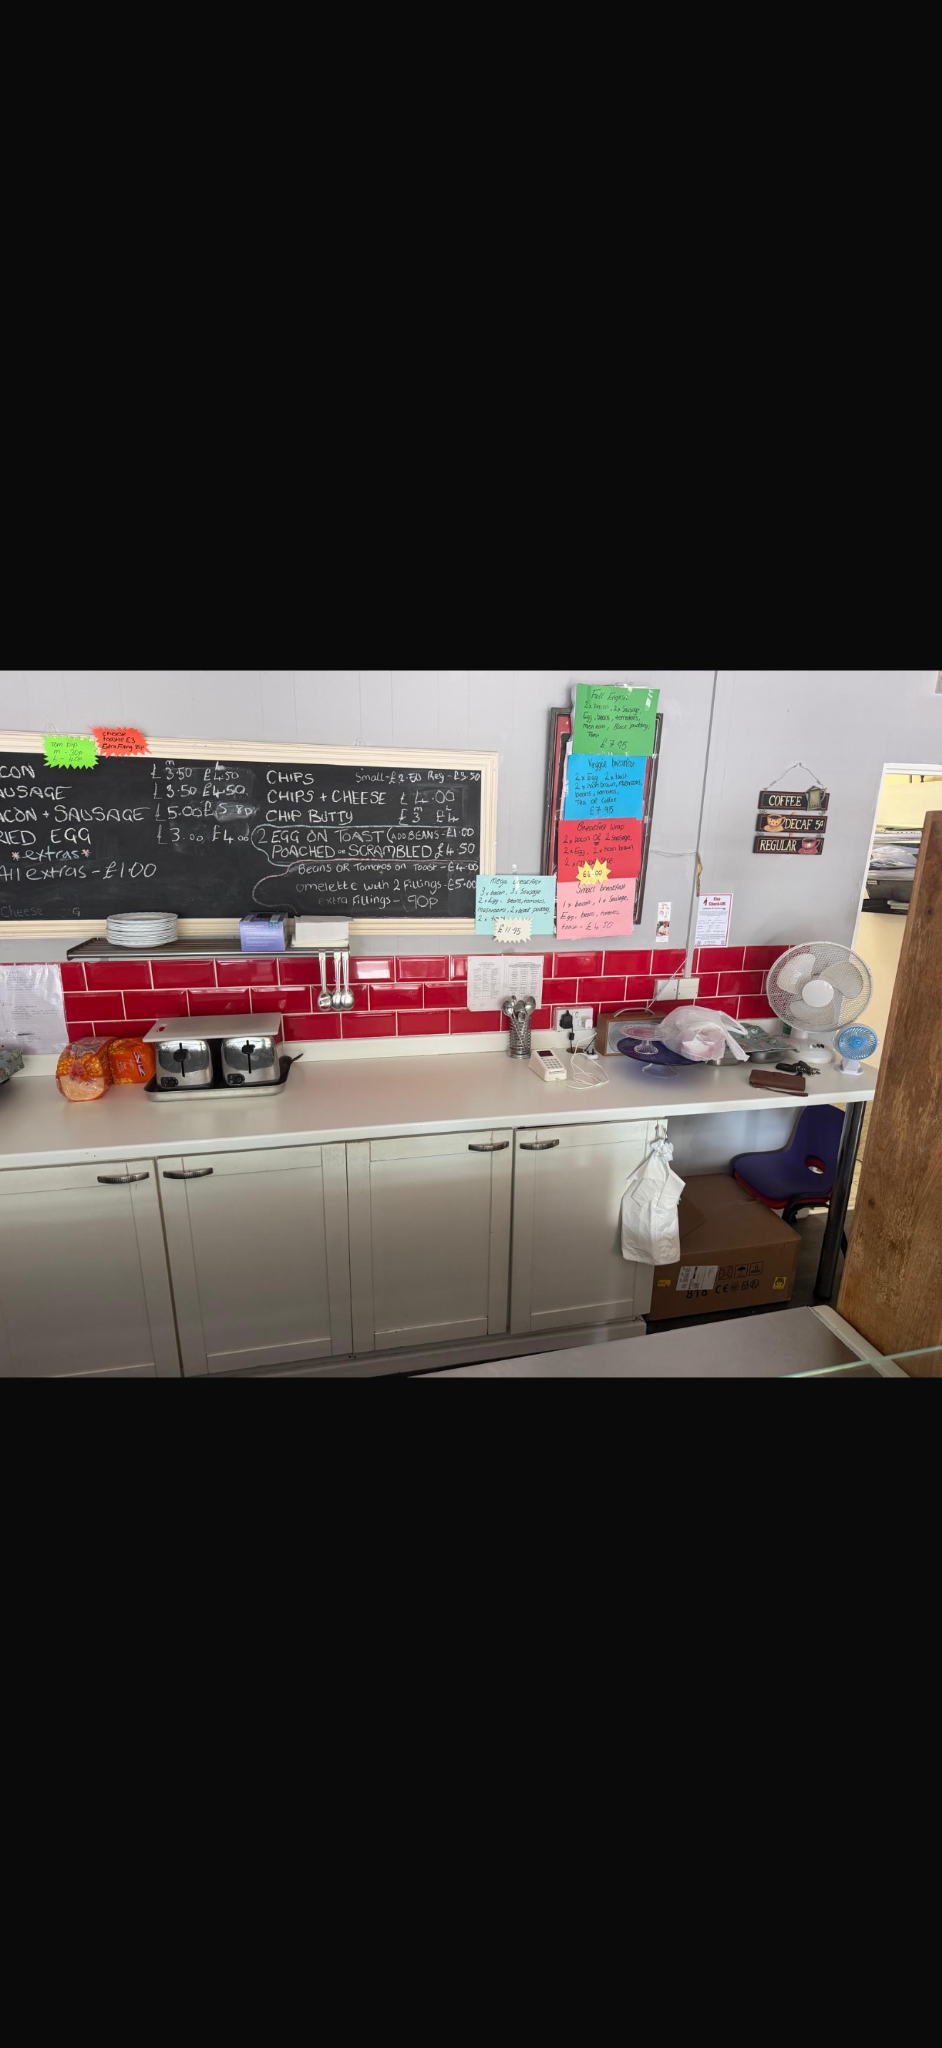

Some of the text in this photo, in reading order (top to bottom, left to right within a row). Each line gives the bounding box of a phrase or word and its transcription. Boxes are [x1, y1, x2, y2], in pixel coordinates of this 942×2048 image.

[590, 689, 605, 700] Full
[266, 769, 315, 785] CHIPS
[266, 789, 315, 804] CHIPS
[331, 789, 387, 805] CHEESE
[768, 794, 803, 807] COFFEE
[54, 804, 151, 823] SAUSAGE
[266, 809, 302, 823] CHIP
[308, 809, 354, 826] BUTTY
[784, 817, 814, 831] DECAF
[50, 827, 92, 845] EGG
[271, 829, 300, 845] EGG
[306, 828, 329, 844] ON
[333, 828, 385, 845] TOAST
[271, 844, 336, 859] POACHED
[348, 844, 433, 860] SCRAMBLED
[759, 838, 797, 852] REGULAR
[298, 863, 333, 876] Beans
[336, 863, 351, 873] OR
[394, 862, 407, 871] on
[363, 879, 390, 891] with
[393, 878, 401, 891] 2
[407, 894, 439, 909] 90p
